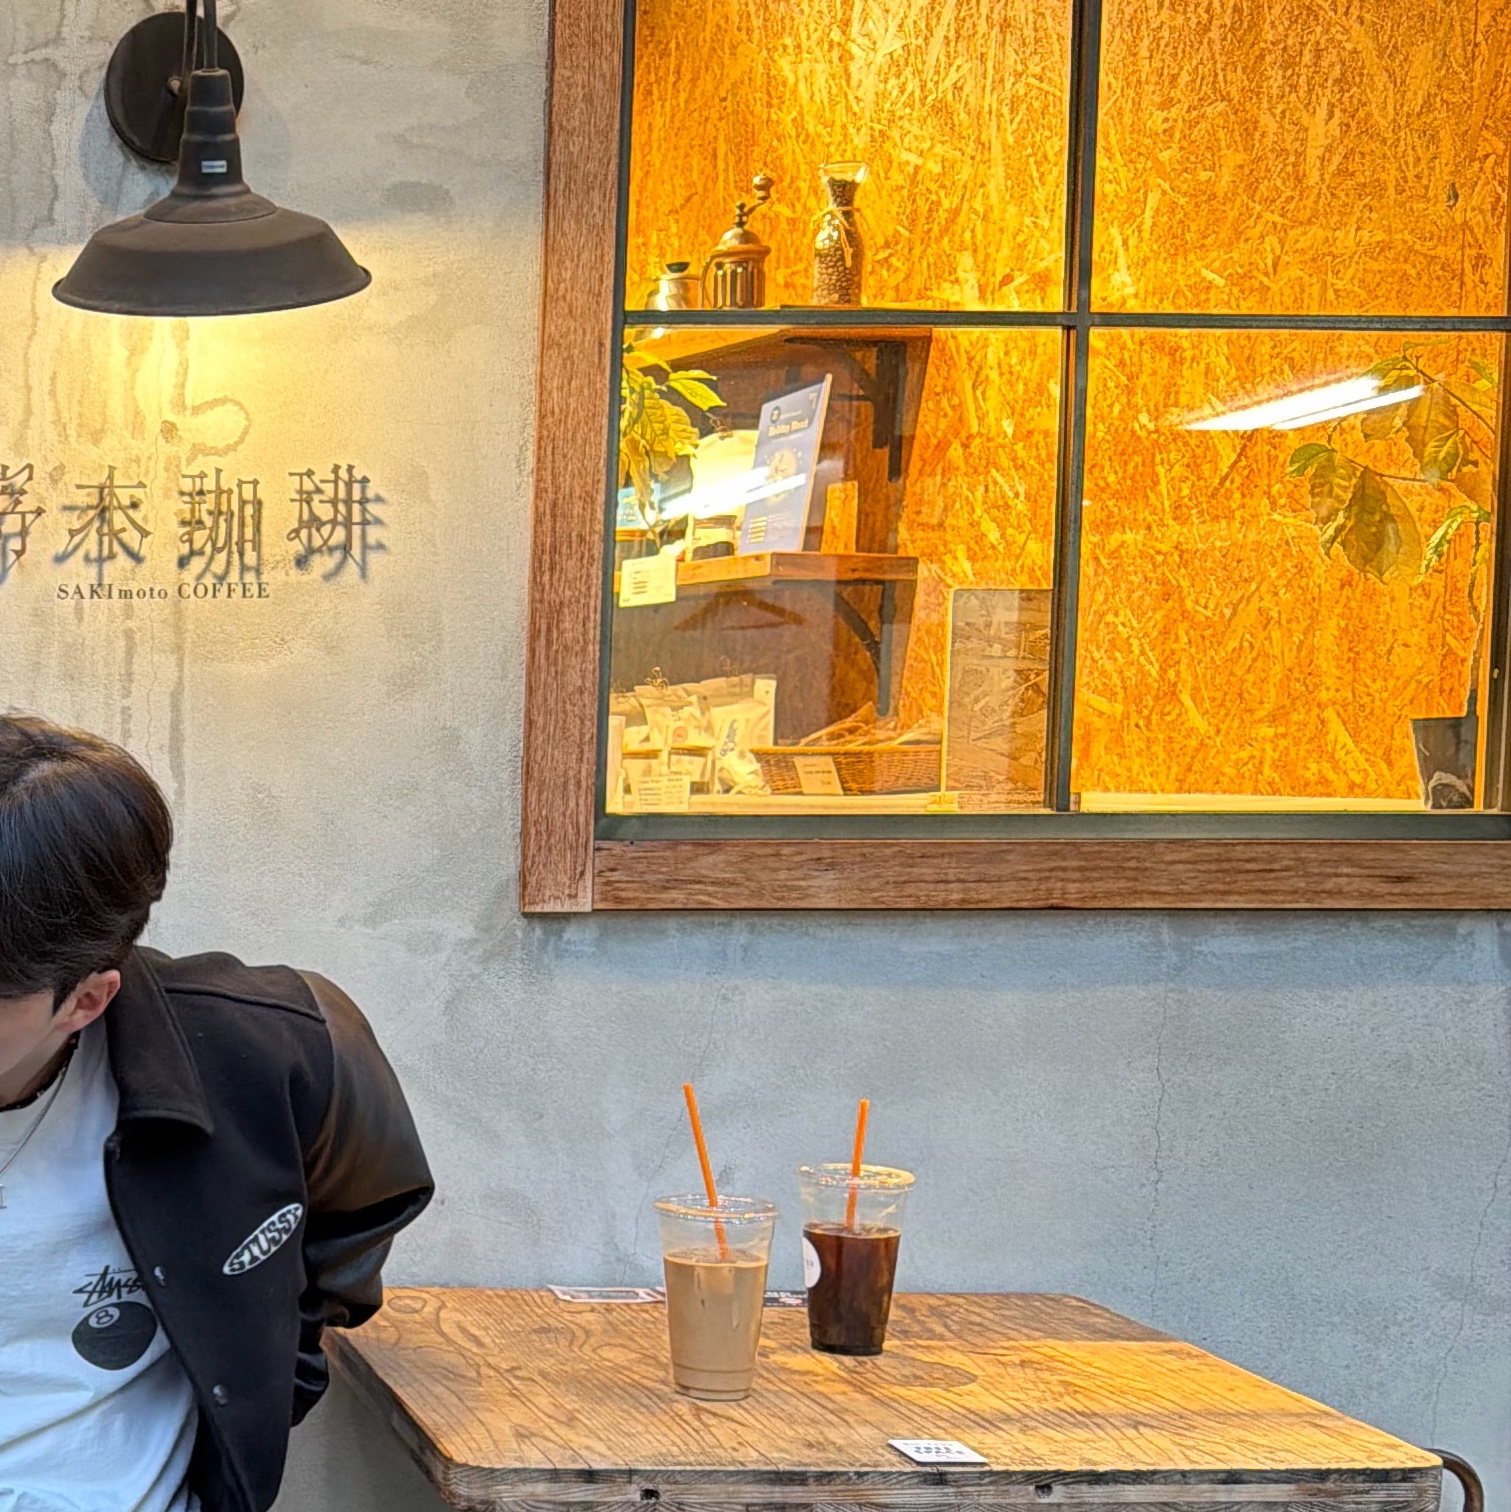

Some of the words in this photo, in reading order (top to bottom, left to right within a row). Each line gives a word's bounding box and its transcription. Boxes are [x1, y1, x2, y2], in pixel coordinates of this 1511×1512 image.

[57, 582, 167, 600] SAKImoto
[178, 582, 271, 600] COFFEE
[228, 1205, 300, 1273] STUSSY
[95, 1309, 114, 1325] 8
